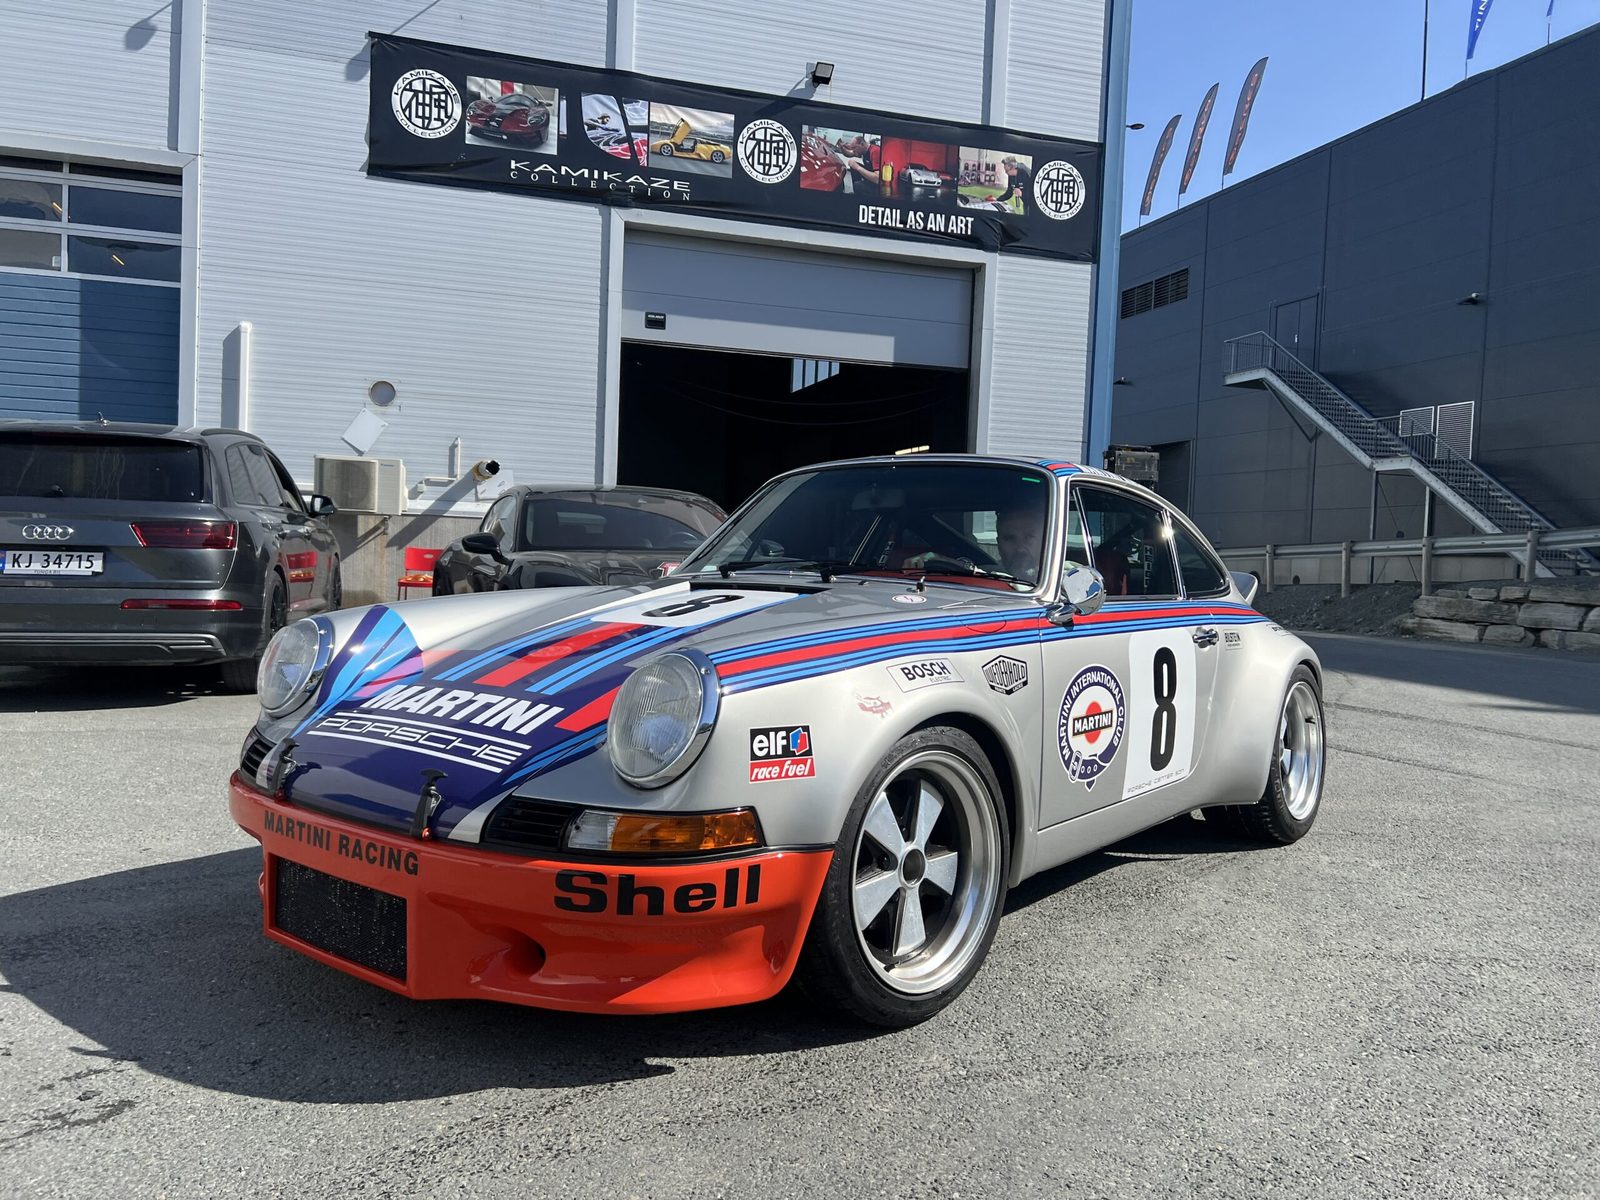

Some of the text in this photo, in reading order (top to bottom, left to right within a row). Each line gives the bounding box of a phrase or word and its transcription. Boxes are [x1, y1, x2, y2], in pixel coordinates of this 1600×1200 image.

[394, 70, 461, 104] KAMIKAZE
[395, 110, 458, 138] COLLECTION
[739, 120, 796, 151] KAMIKAZE
[509, 170, 691, 201] COLLECTION
[510, 159, 691, 192] KAMIKAZE
[858, 204, 974, 235] DETAIL AS AN ART
[12, 553, 95, 569] KJ 34715
[641, 594, 746, 618] 8
[899, 661, 952, 681] BOSCH
[359, 684, 565, 736] MARTINI
[1059, 671, 1125, 761] MARTINI INTERNATIONAL CLUB
[1074, 712, 1112, 733] MARTINI
[1149, 646, 1178, 772] 8
[314, 717, 522, 766] PORSCHE
[752, 730, 787, 757] elf
[751, 758, 812, 780] race fuel
[263, 809, 420, 876] MARTINI RACING
[553, 863, 762, 916] Shell
